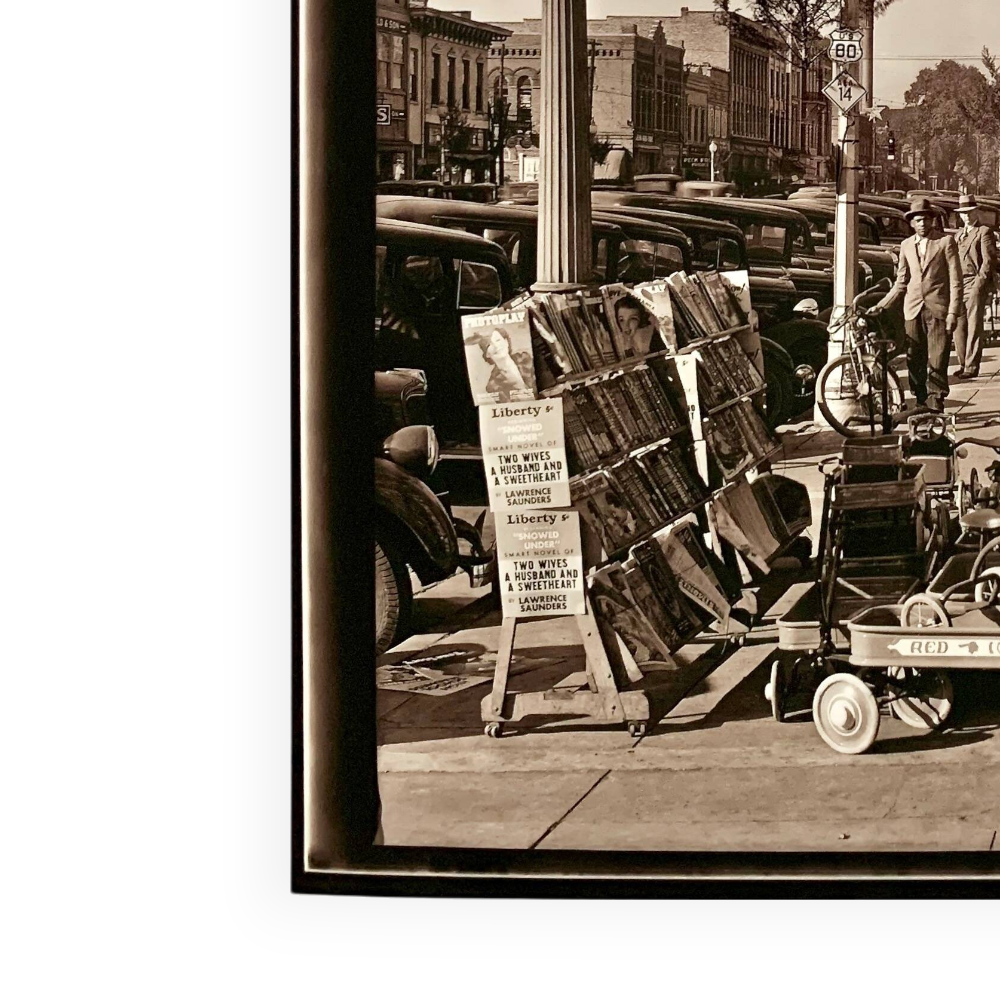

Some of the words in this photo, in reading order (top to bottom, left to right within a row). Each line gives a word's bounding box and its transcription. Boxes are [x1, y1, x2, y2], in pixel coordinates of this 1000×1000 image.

[835, 43, 856, 58] 80
[839, 87, 852, 101] 14
[492, 406, 541, 418] Liberty
[498, 454, 518, 465] TWO
[522, 450, 551, 462] WIVES
[491, 466, 497, 476] A
[500, 462, 540, 475] HUSBAND
[544, 461, 562, 471] AND
[494, 477, 500, 486] A
[504, 471, 561, 485] SWEETHEART
[505, 487, 551, 498] LAWRENCE
[507, 495, 552, 506] SAUNDERS
[507, 513, 557, 525] Liberty
[513, 560, 534, 571] TWO
[538, 558, 568, 569] WIVES
[505, 572, 510, 582] A
[514, 569, 556, 581] HUSBAND
[560, 569, 578, 579] AND
[508, 582, 514, 592] A
[518, 579, 576, 592] SWEETHEART
[518, 594, 567, 605] LAWRENCE
[520, 602, 567, 612] SAUNDERS
[910, 640, 949, 654] RED
